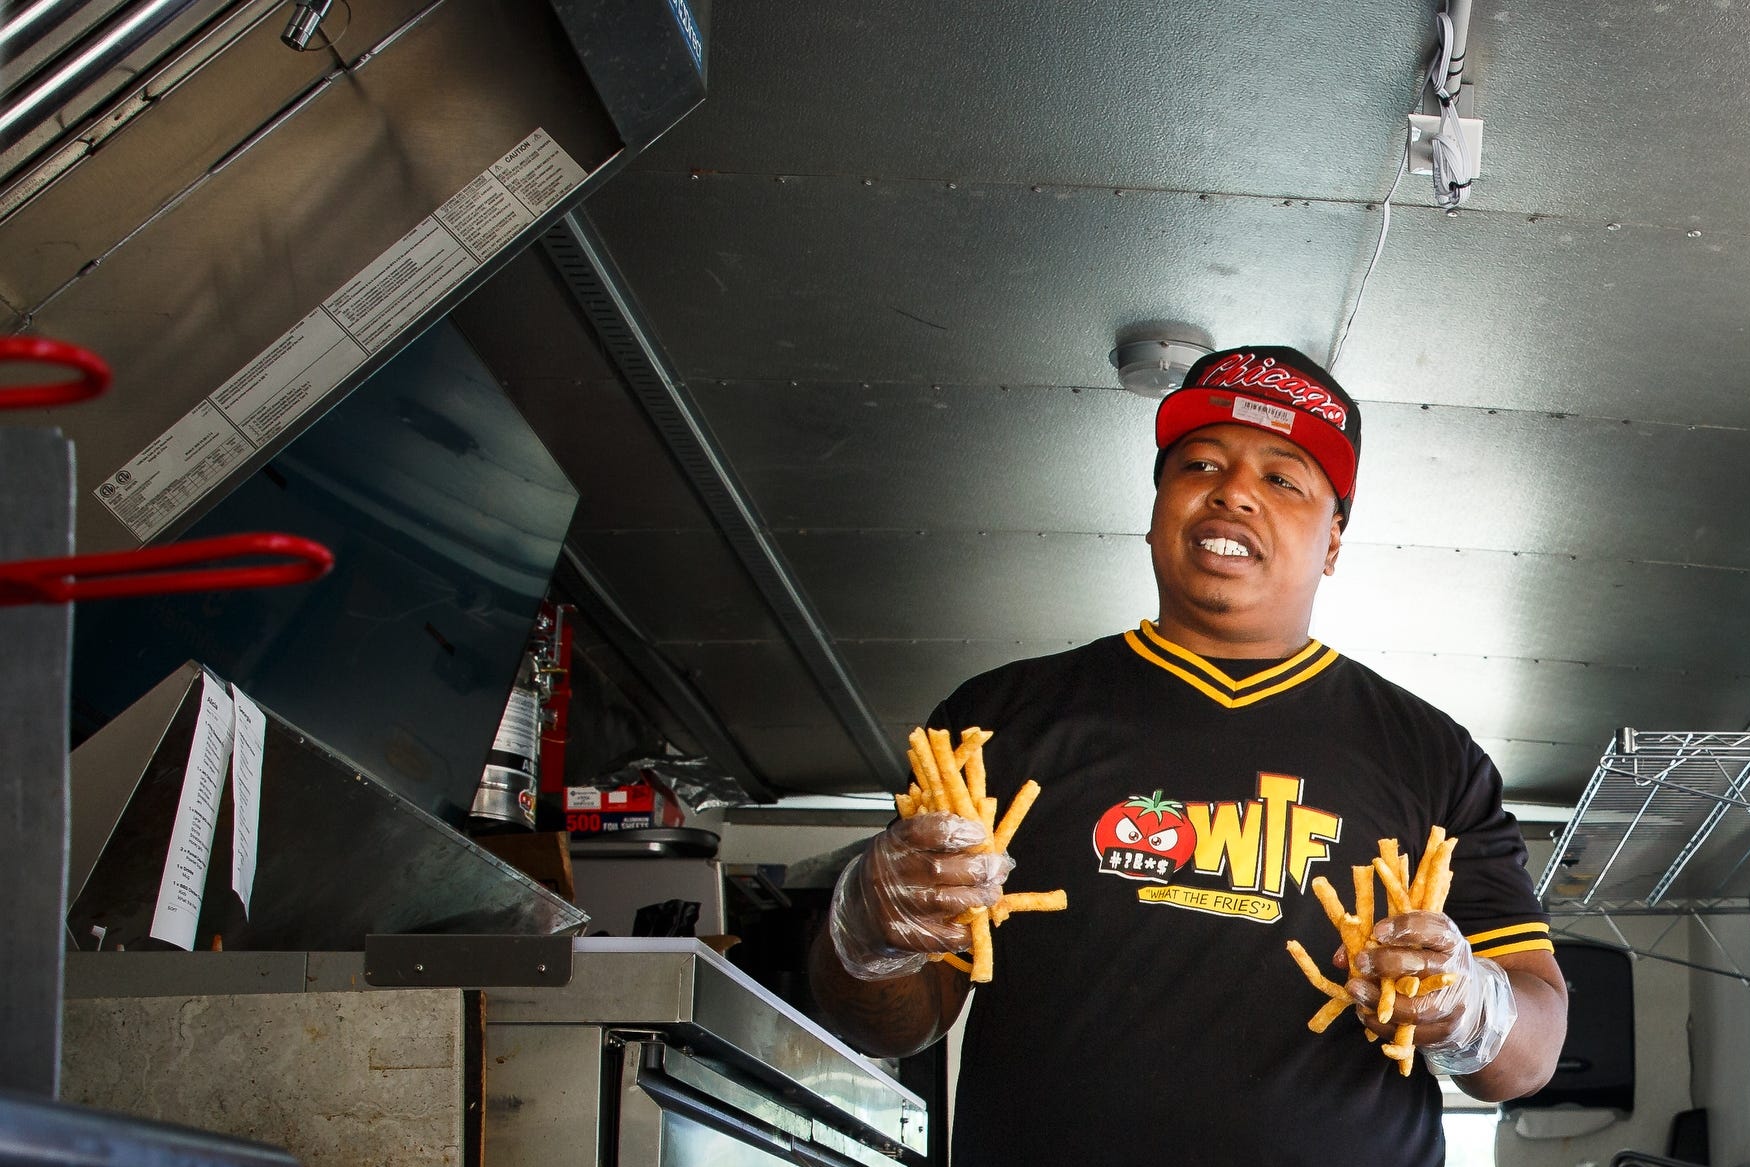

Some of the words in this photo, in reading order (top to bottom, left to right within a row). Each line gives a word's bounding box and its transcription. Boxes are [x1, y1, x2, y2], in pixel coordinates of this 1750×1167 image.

[504, 140, 531, 163] CAUTION
[1202, 353, 1346, 431] Chicago
[567, 814, 600, 832] 500
[1186, 771, 1343, 897] WTF
[1183, 891, 1208, 905] THE
